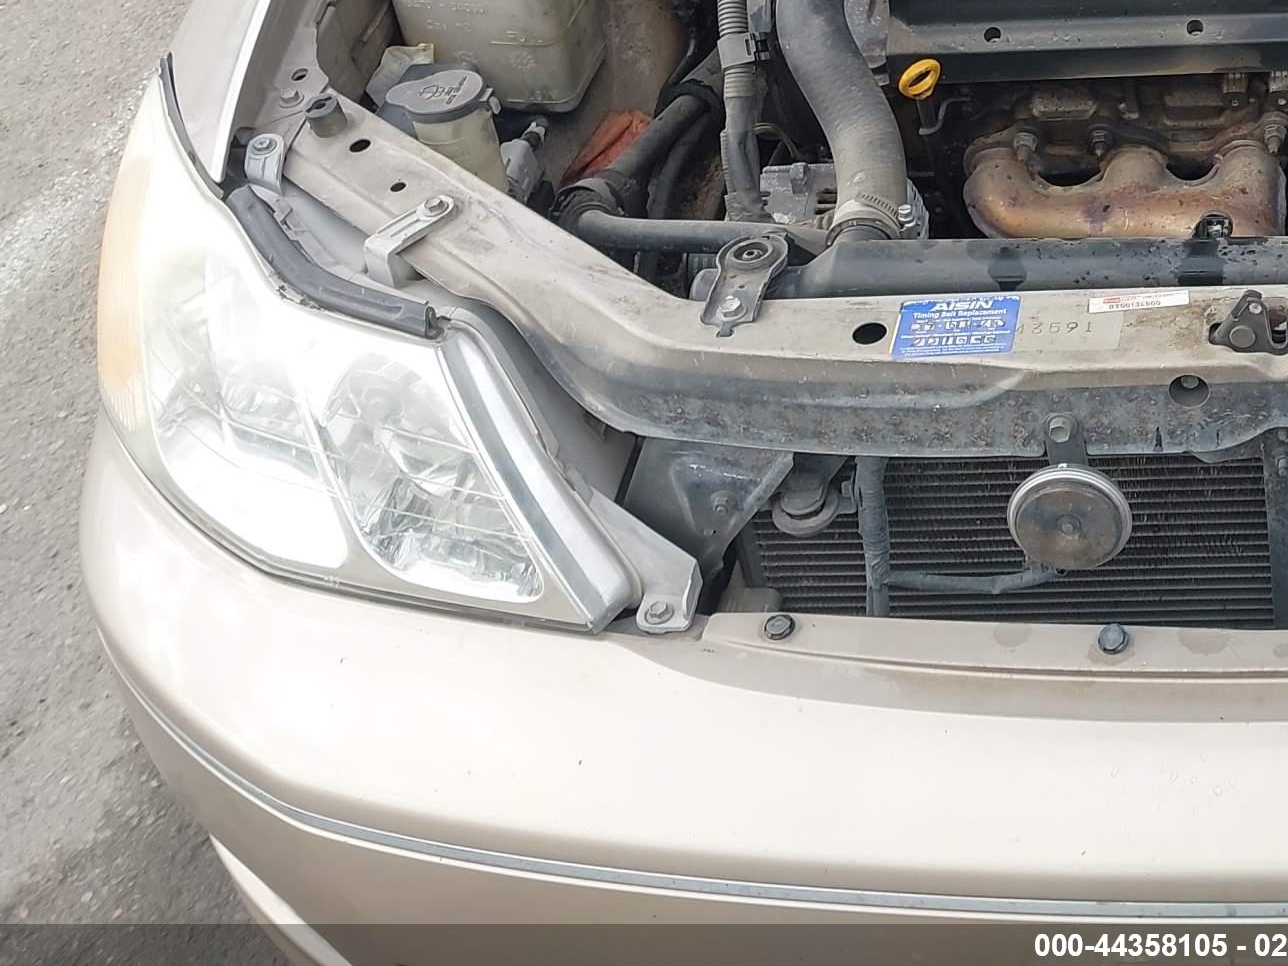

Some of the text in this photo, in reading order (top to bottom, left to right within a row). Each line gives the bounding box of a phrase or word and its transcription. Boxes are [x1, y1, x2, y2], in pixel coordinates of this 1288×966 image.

[929, 300, 994, 312] AISIN
[913, 309, 1008, 320] Timing Belt Replacement
